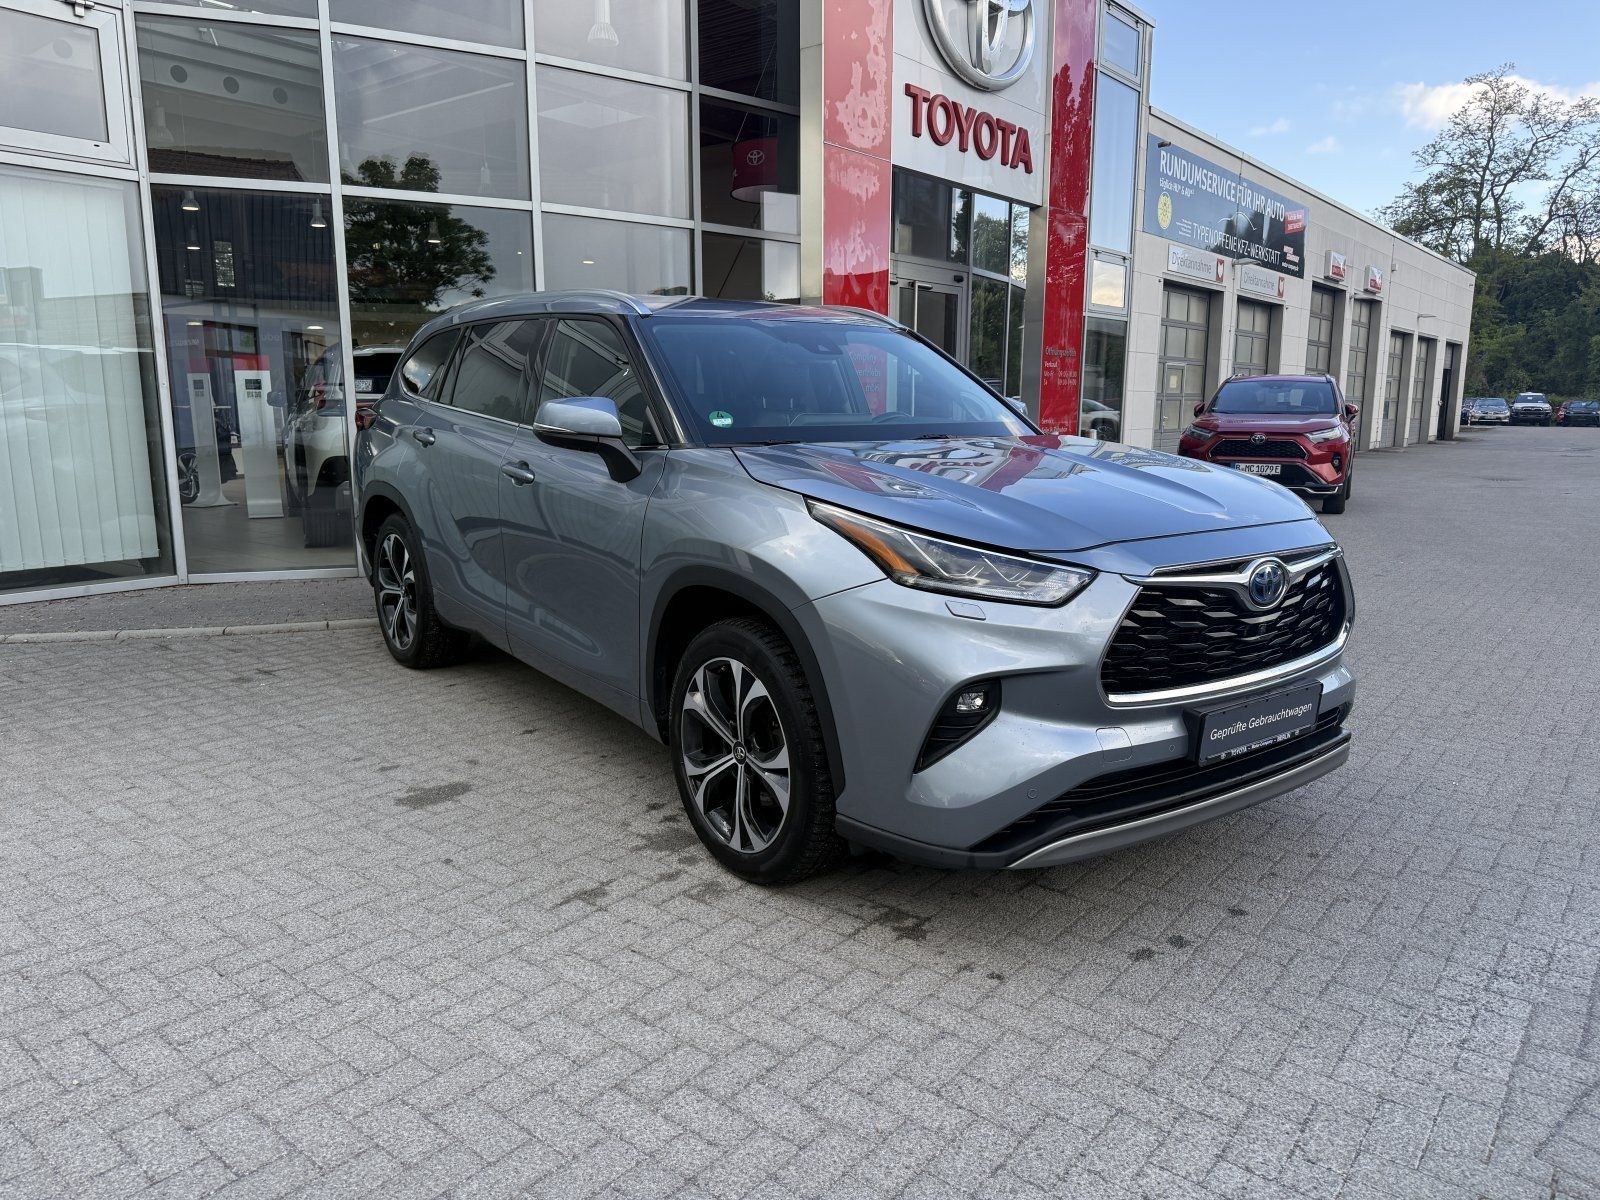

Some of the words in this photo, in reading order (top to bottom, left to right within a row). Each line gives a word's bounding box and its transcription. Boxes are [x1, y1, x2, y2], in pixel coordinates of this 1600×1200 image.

[904, 83, 1033, 174] TOYOTA
[1160, 150, 1235, 202] RUNDUMSERVICE
[1236, 182, 1252, 209] FÜR
[1253, 191, 1265, 215] IHR
[1265, 197, 1285, 222] AUTO
[1193, 223, 1238, 252] TYPENOFFENE
[1237, 236, 1281, 266] KFZ-WERKSTATT
[1171, 251, 1212, 275] Direktannahme
[1243, 271, 1275, 290] Direktannahme
[716, 411, 724, 419] 4
[1210, 721, 1247, 741] Geprüfte
[1248, 703, 1313, 729] Gebrauchtwagen
[1231, 745, 1248, 756] TOYOTA
[1276, 733, 1291, 742] BERLIN
